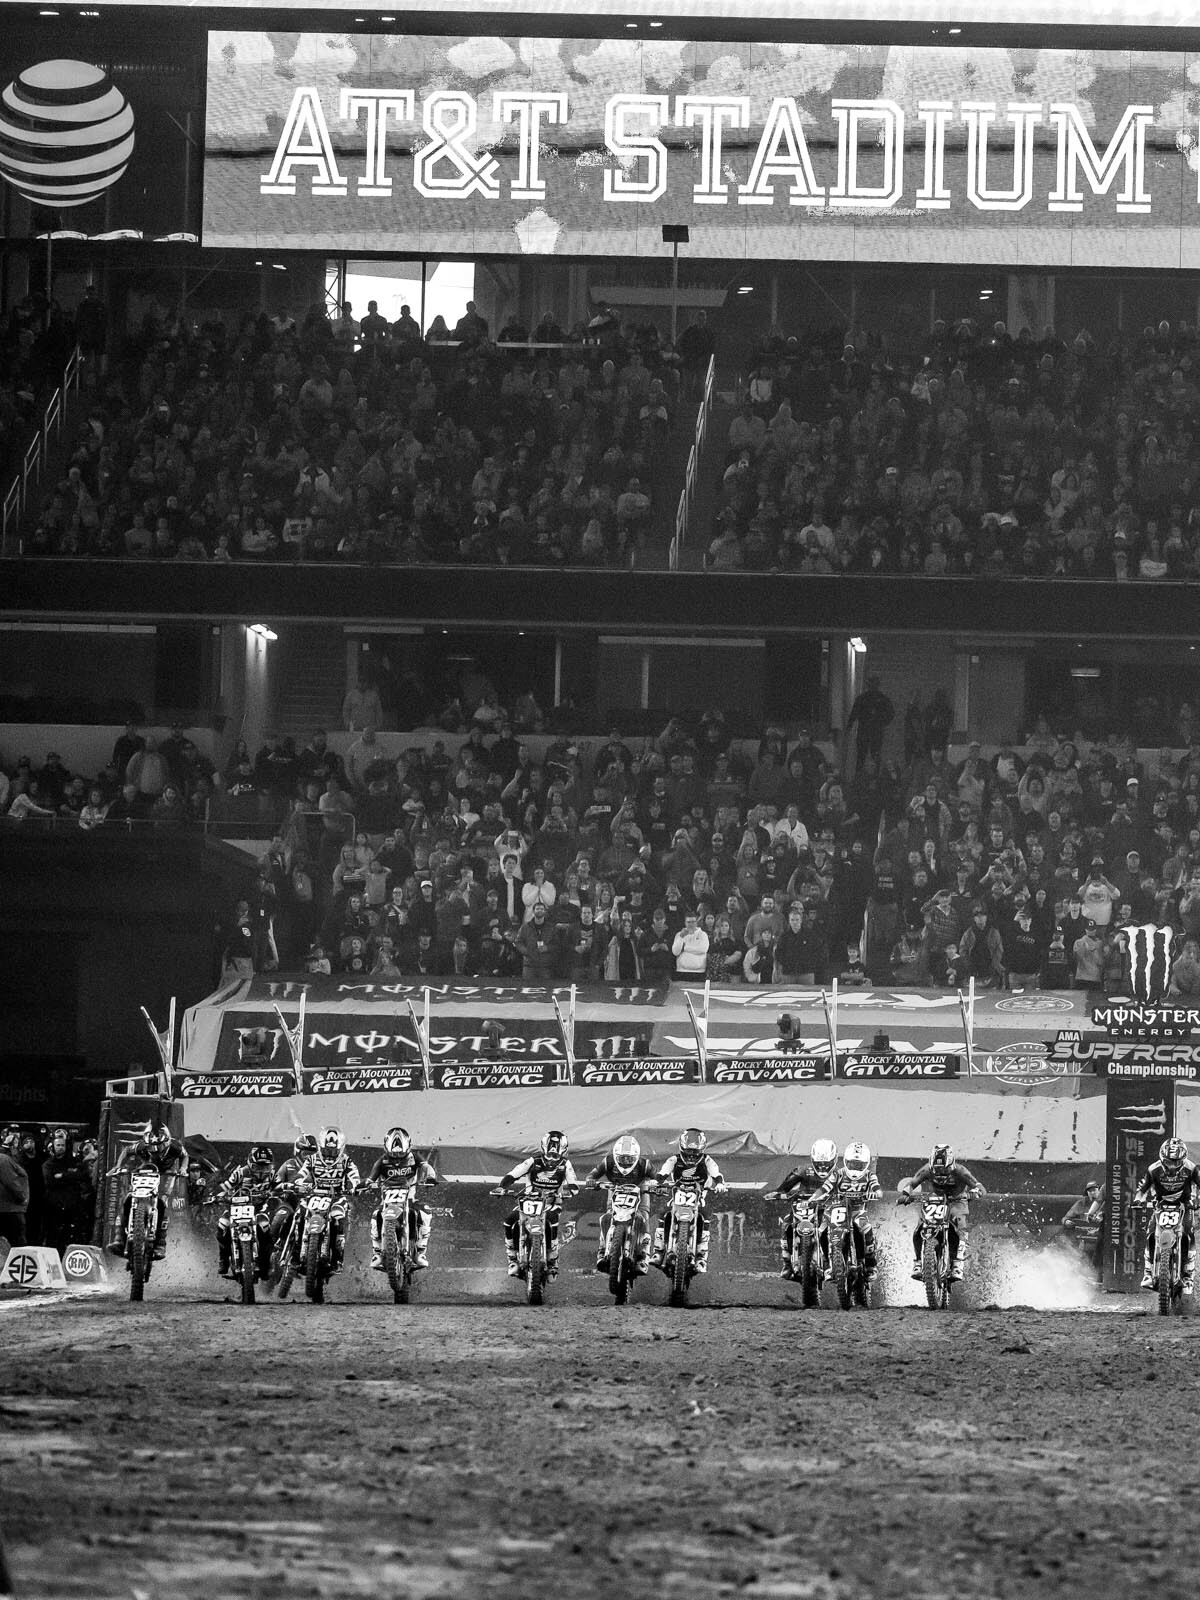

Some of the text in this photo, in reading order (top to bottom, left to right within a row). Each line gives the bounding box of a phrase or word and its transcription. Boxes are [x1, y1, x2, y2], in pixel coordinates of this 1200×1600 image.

[260, 86, 568, 200] AT&T
[604, 95, 1153, 213] STADIUM
[1058, 1032, 1080, 1041] AMA
[1111, 1028, 1185, 1036] ENERGY
[861, 1056, 892, 1064] ROCKY
[327, 1069, 411, 1080] ROCKY MOUNTAIN
[458, 1066, 489, 1074] ROCKY
[1108, 1063, 1196, 1078] Championship
[198, 1076, 229, 1084] ROCKY
[385, 1189, 407, 1203] 125
[615, 1194, 637, 1206] 50
[675, 1190, 696, 1205] 62
[308, 1196, 332, 1210] 66
[523, 1201, 543, 1214] 67
[1112, 1164, 1121, 1244] CHAMPIONSHIP
[231, 1205, 255, 1217] 99
[831, 1207, 847, 1223] 6
[924, 1204, 947, 1219] 29
[1158, 1211, 1179, 1225] 63
[71, 1258, 87, 1269] RM
